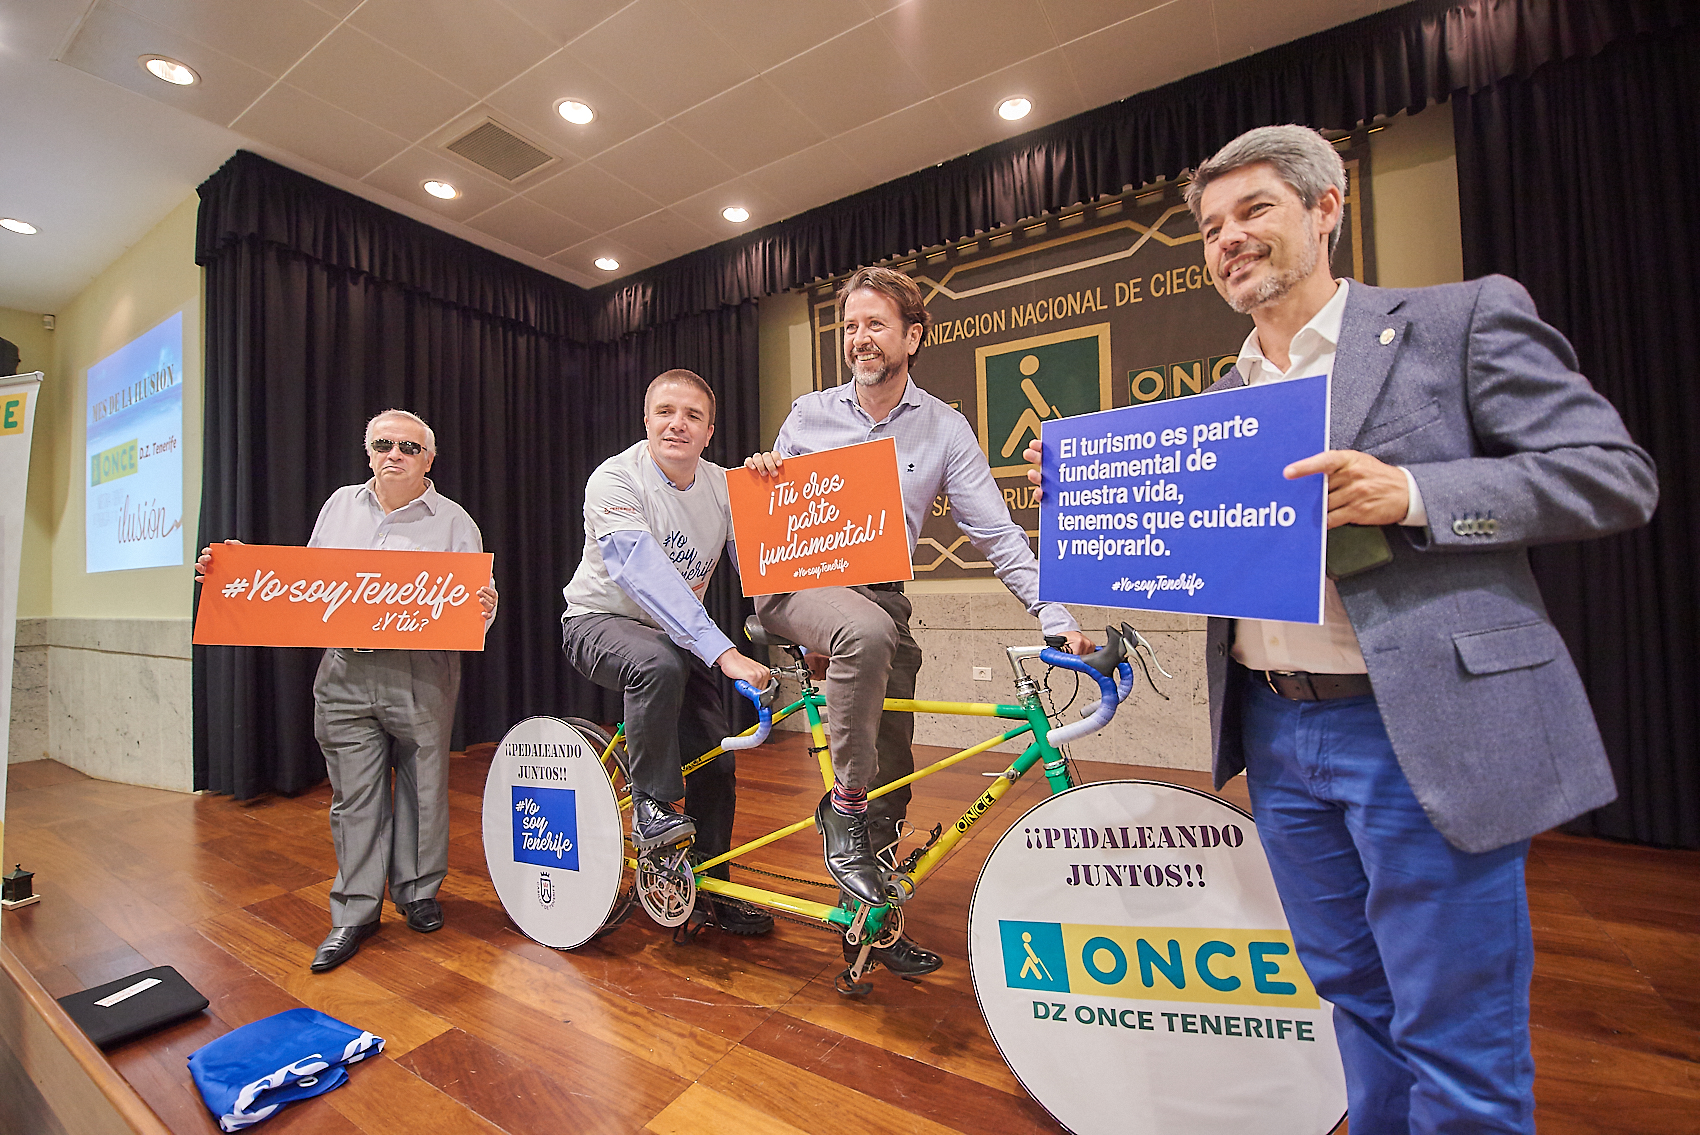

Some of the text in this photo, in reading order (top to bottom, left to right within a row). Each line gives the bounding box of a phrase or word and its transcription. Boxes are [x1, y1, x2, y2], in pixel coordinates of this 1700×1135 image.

[924, 309, 1006, 347] NIZACION
[1011, 289, 1108, 329] NACIONAL
[1115, 277, 1143, 307] DE
[109, 392, 120, 415] DE
[121, 385, 133, 409] LA
[134, 361, 174, 403] ILUSIÓN
[1060, 414, 1260, 459] El turismo es parte
[102, 434, 177, 477] ONCE D.Z. Tenerife
[1058, 448, 1217, 483] fundamental de
[801, 471, 845, 500] eres
[1001, 486, 1040, 511] RUZ
[1058, 479, 1184, 507] nuestra vida,
[118, 494, 182, 544] ilusión
[786, 497, 840, 541] parte
[1057, 501, 1296, 534] tenemos que cuidarlo
[662, 530, 688, 549] #Yo
[1057, 534, 1171, 561] y mejorarlo.
[669, 547, 698, 570] soy
[505, 743, 583, 759] ¡¡PEDALEANDO
[517, 765, 567, 782] JUNTOS!!
[515, 798, 540, 815] #Yo
[956, 791, 997, 834] ONCE
[522, 816, 549, 838] soy
[1024, 824, 1244, 850] ¡¡PEDALEANDO
[521, 832, 573, 860] Tenerife
[1066, 863, 1207, 889] JUNTOS!!
[1081, 936, 1297, 996] ONCE
[1032, 1000, 1316, 1043] DZ ONCE TENERIFE
